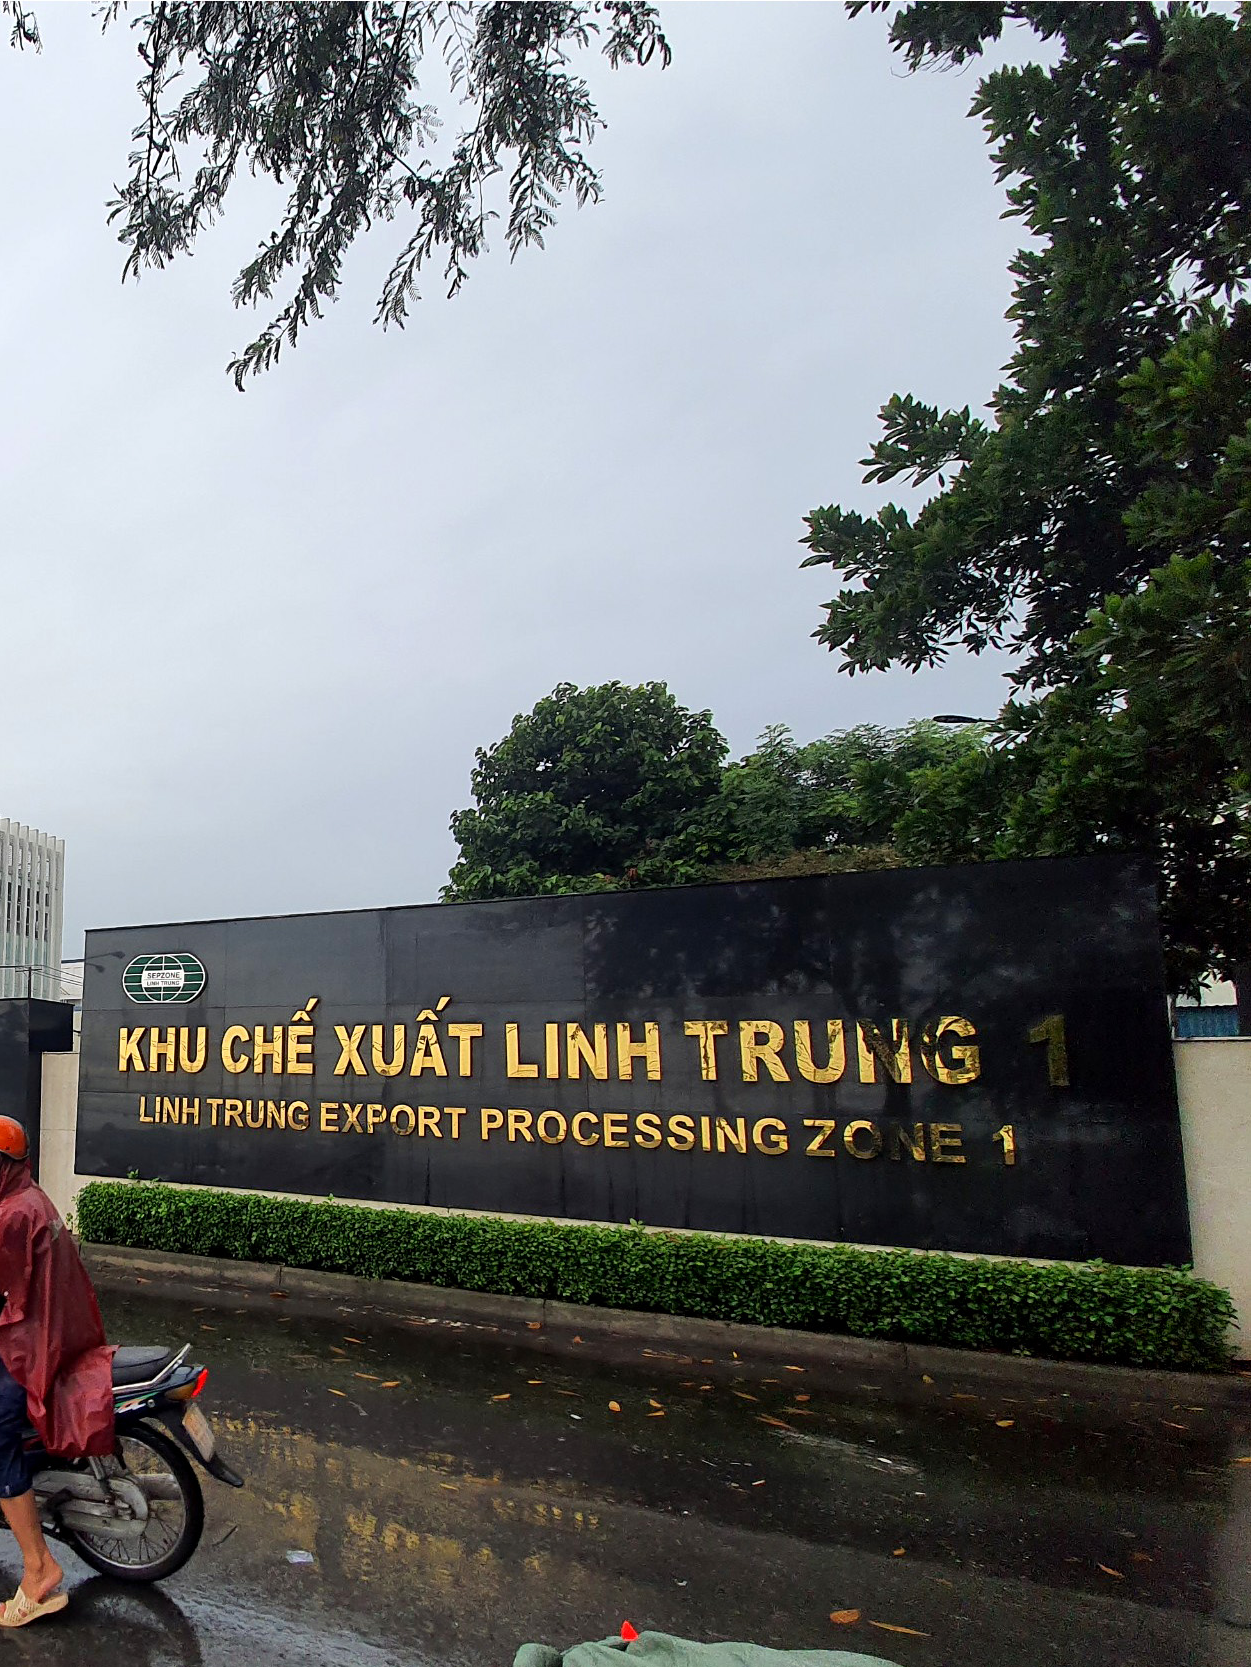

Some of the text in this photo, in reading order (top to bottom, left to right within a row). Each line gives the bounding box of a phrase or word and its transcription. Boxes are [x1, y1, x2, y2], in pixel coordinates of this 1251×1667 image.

[117, 995, 1071, 1087] KHU CHẾ XUẤT LINH TRUNG 1
[138, 1095, 1017, 1166] LINH TRUNG EXPORT PROCESSING ZONE 1
